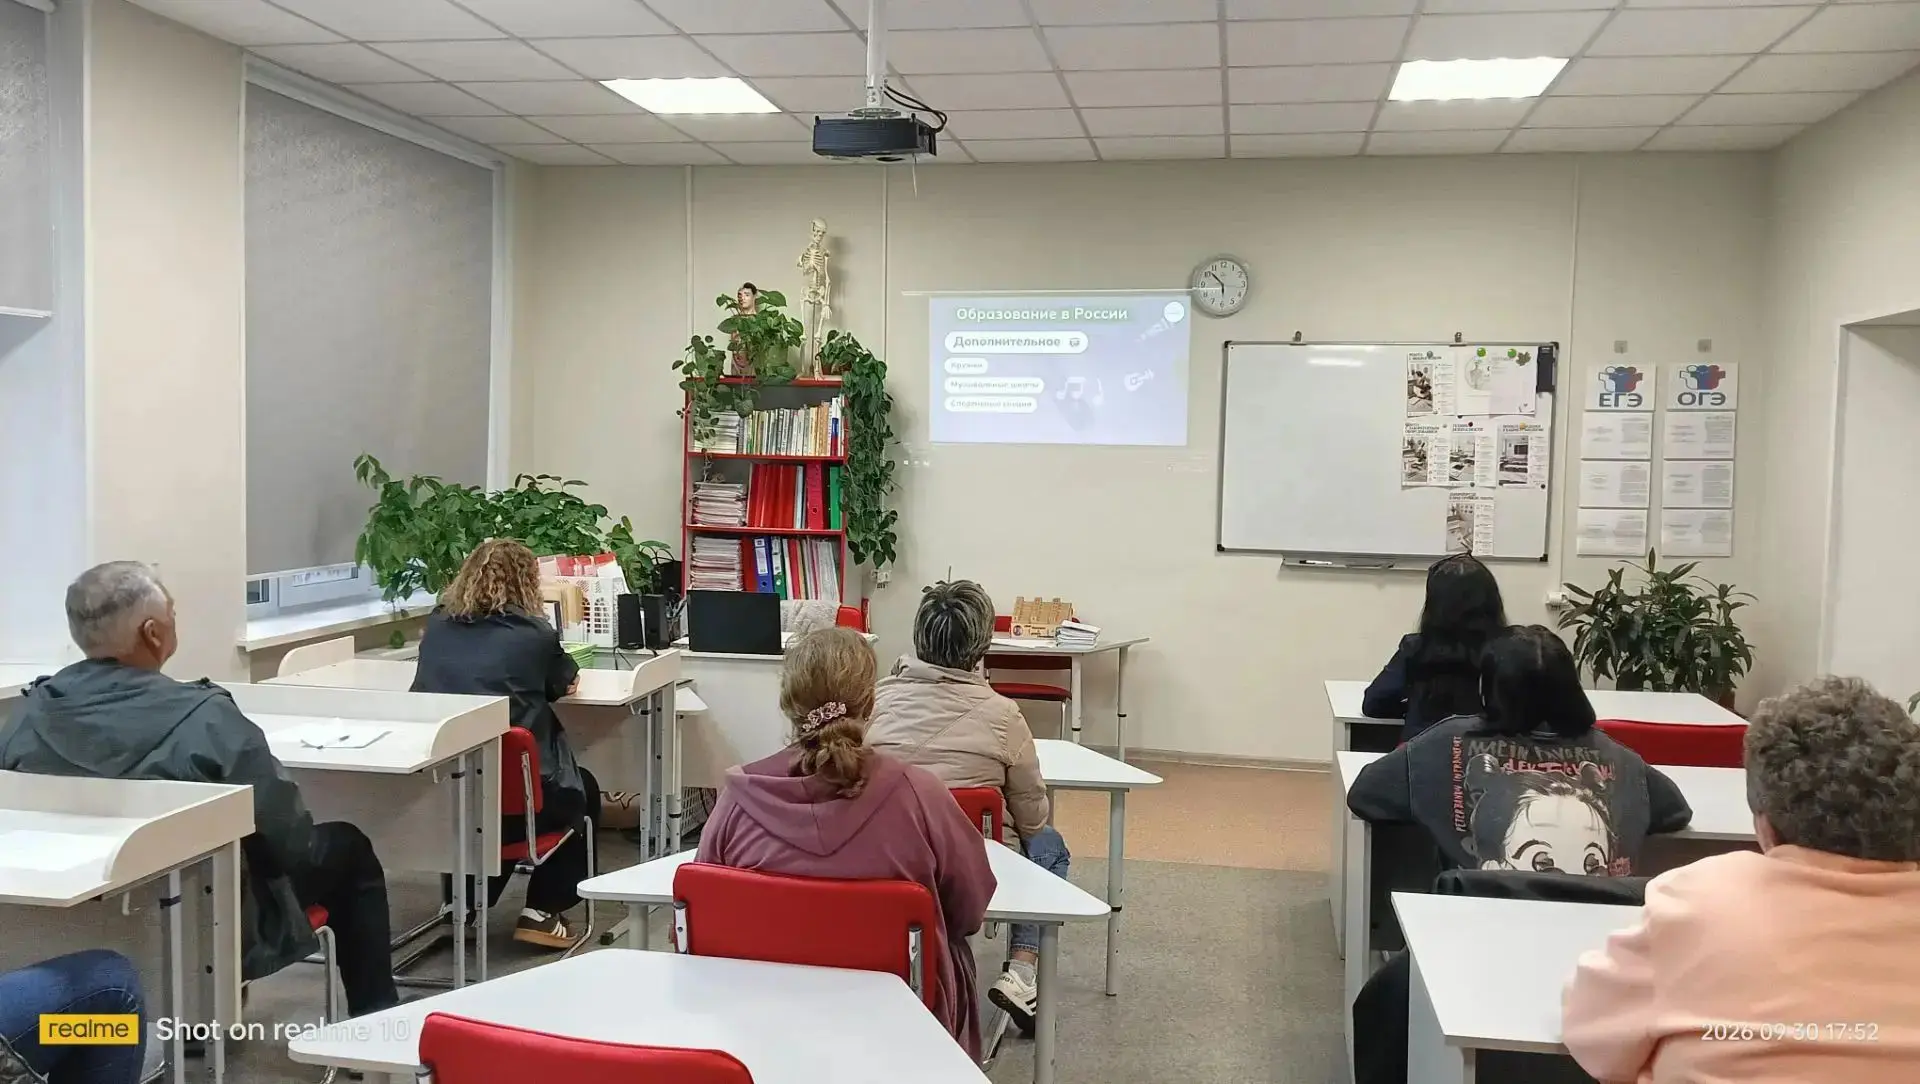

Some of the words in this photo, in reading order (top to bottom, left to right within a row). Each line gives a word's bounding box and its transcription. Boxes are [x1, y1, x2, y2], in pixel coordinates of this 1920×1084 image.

[956, 307, 1057, 322] Образование
[1061, 311, 1070, 320] в
[1074, 307, 1128, 320] России
[953, 336, 1061, 348] Дополнительное
[1599, 392, 1643, 408] ЕГЭ
[1677, 391, 1727, 406] ОГЭ
